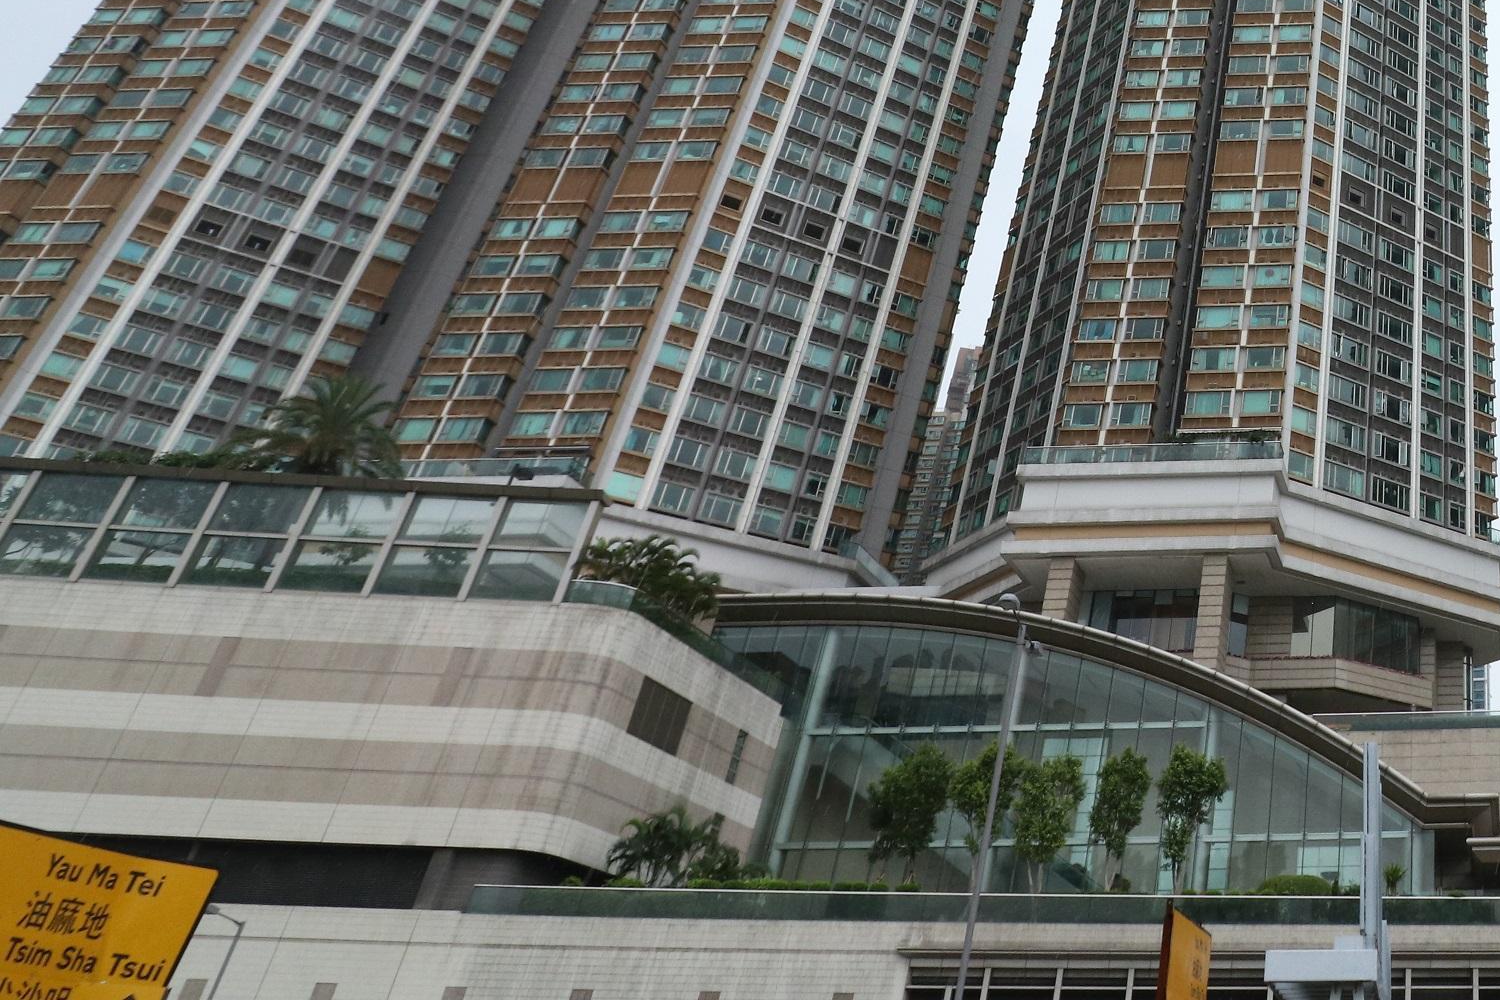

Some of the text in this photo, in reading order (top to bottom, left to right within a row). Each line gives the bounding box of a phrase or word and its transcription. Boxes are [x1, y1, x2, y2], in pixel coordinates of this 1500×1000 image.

[46, 853, 166, 897] Yau Ma Tei
[16, 890, 110, 940] 油麻地
[5, 937, 165, 982] Tsim Sha Tsui
